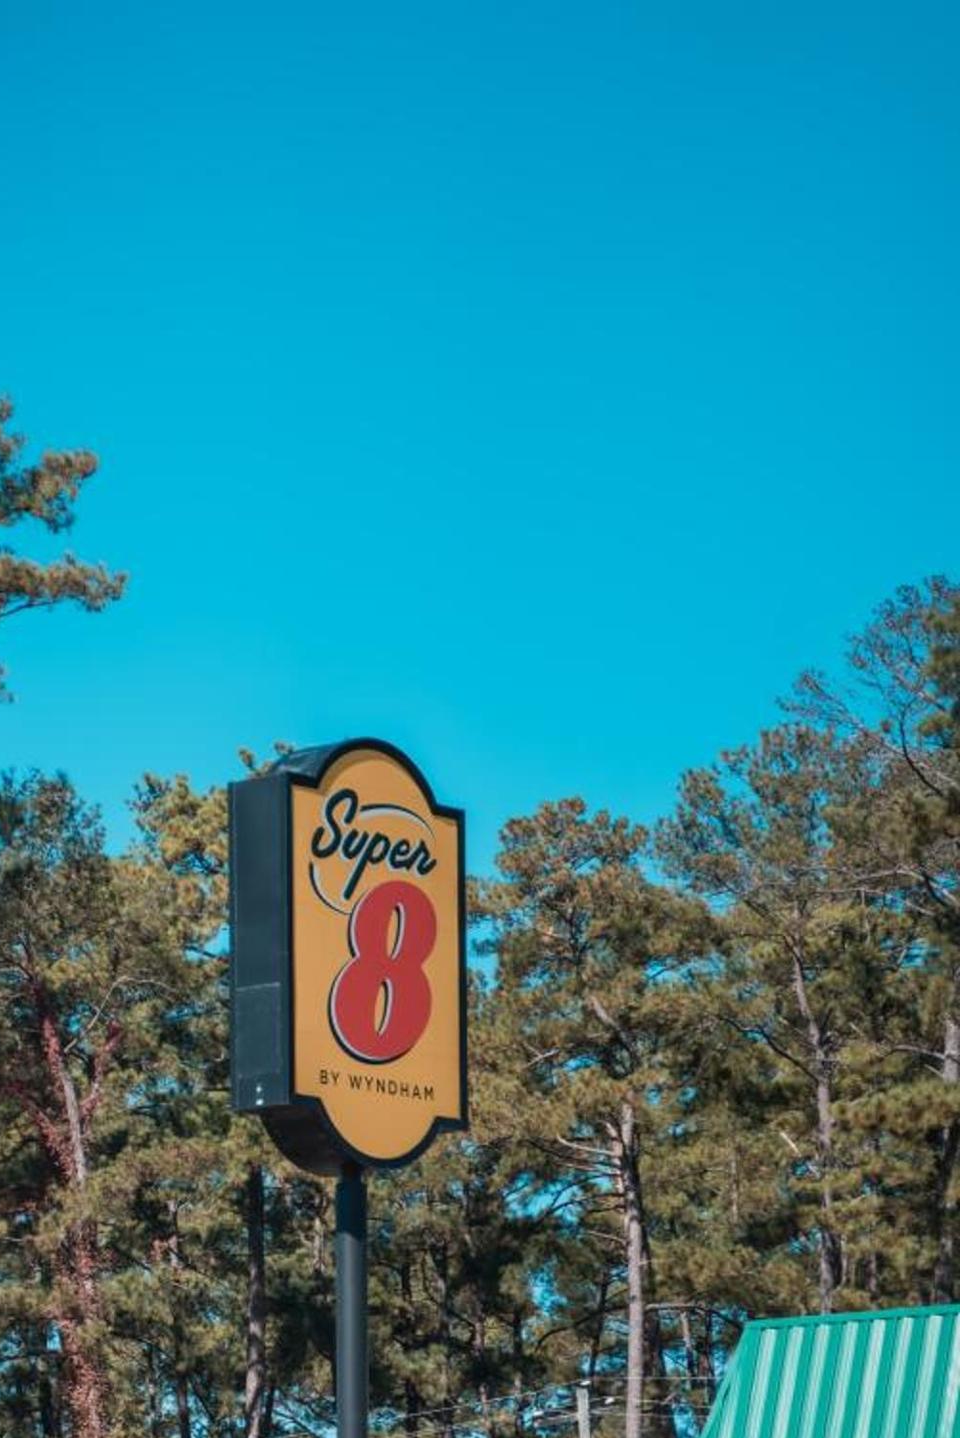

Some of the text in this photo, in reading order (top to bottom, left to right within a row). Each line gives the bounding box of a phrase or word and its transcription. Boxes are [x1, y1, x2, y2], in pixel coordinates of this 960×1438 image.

[311, 788, 437, 900] Super
[328, 880, 438, 1064] 8
[319, 1069, 436, 1101] BY WYNDHAM
